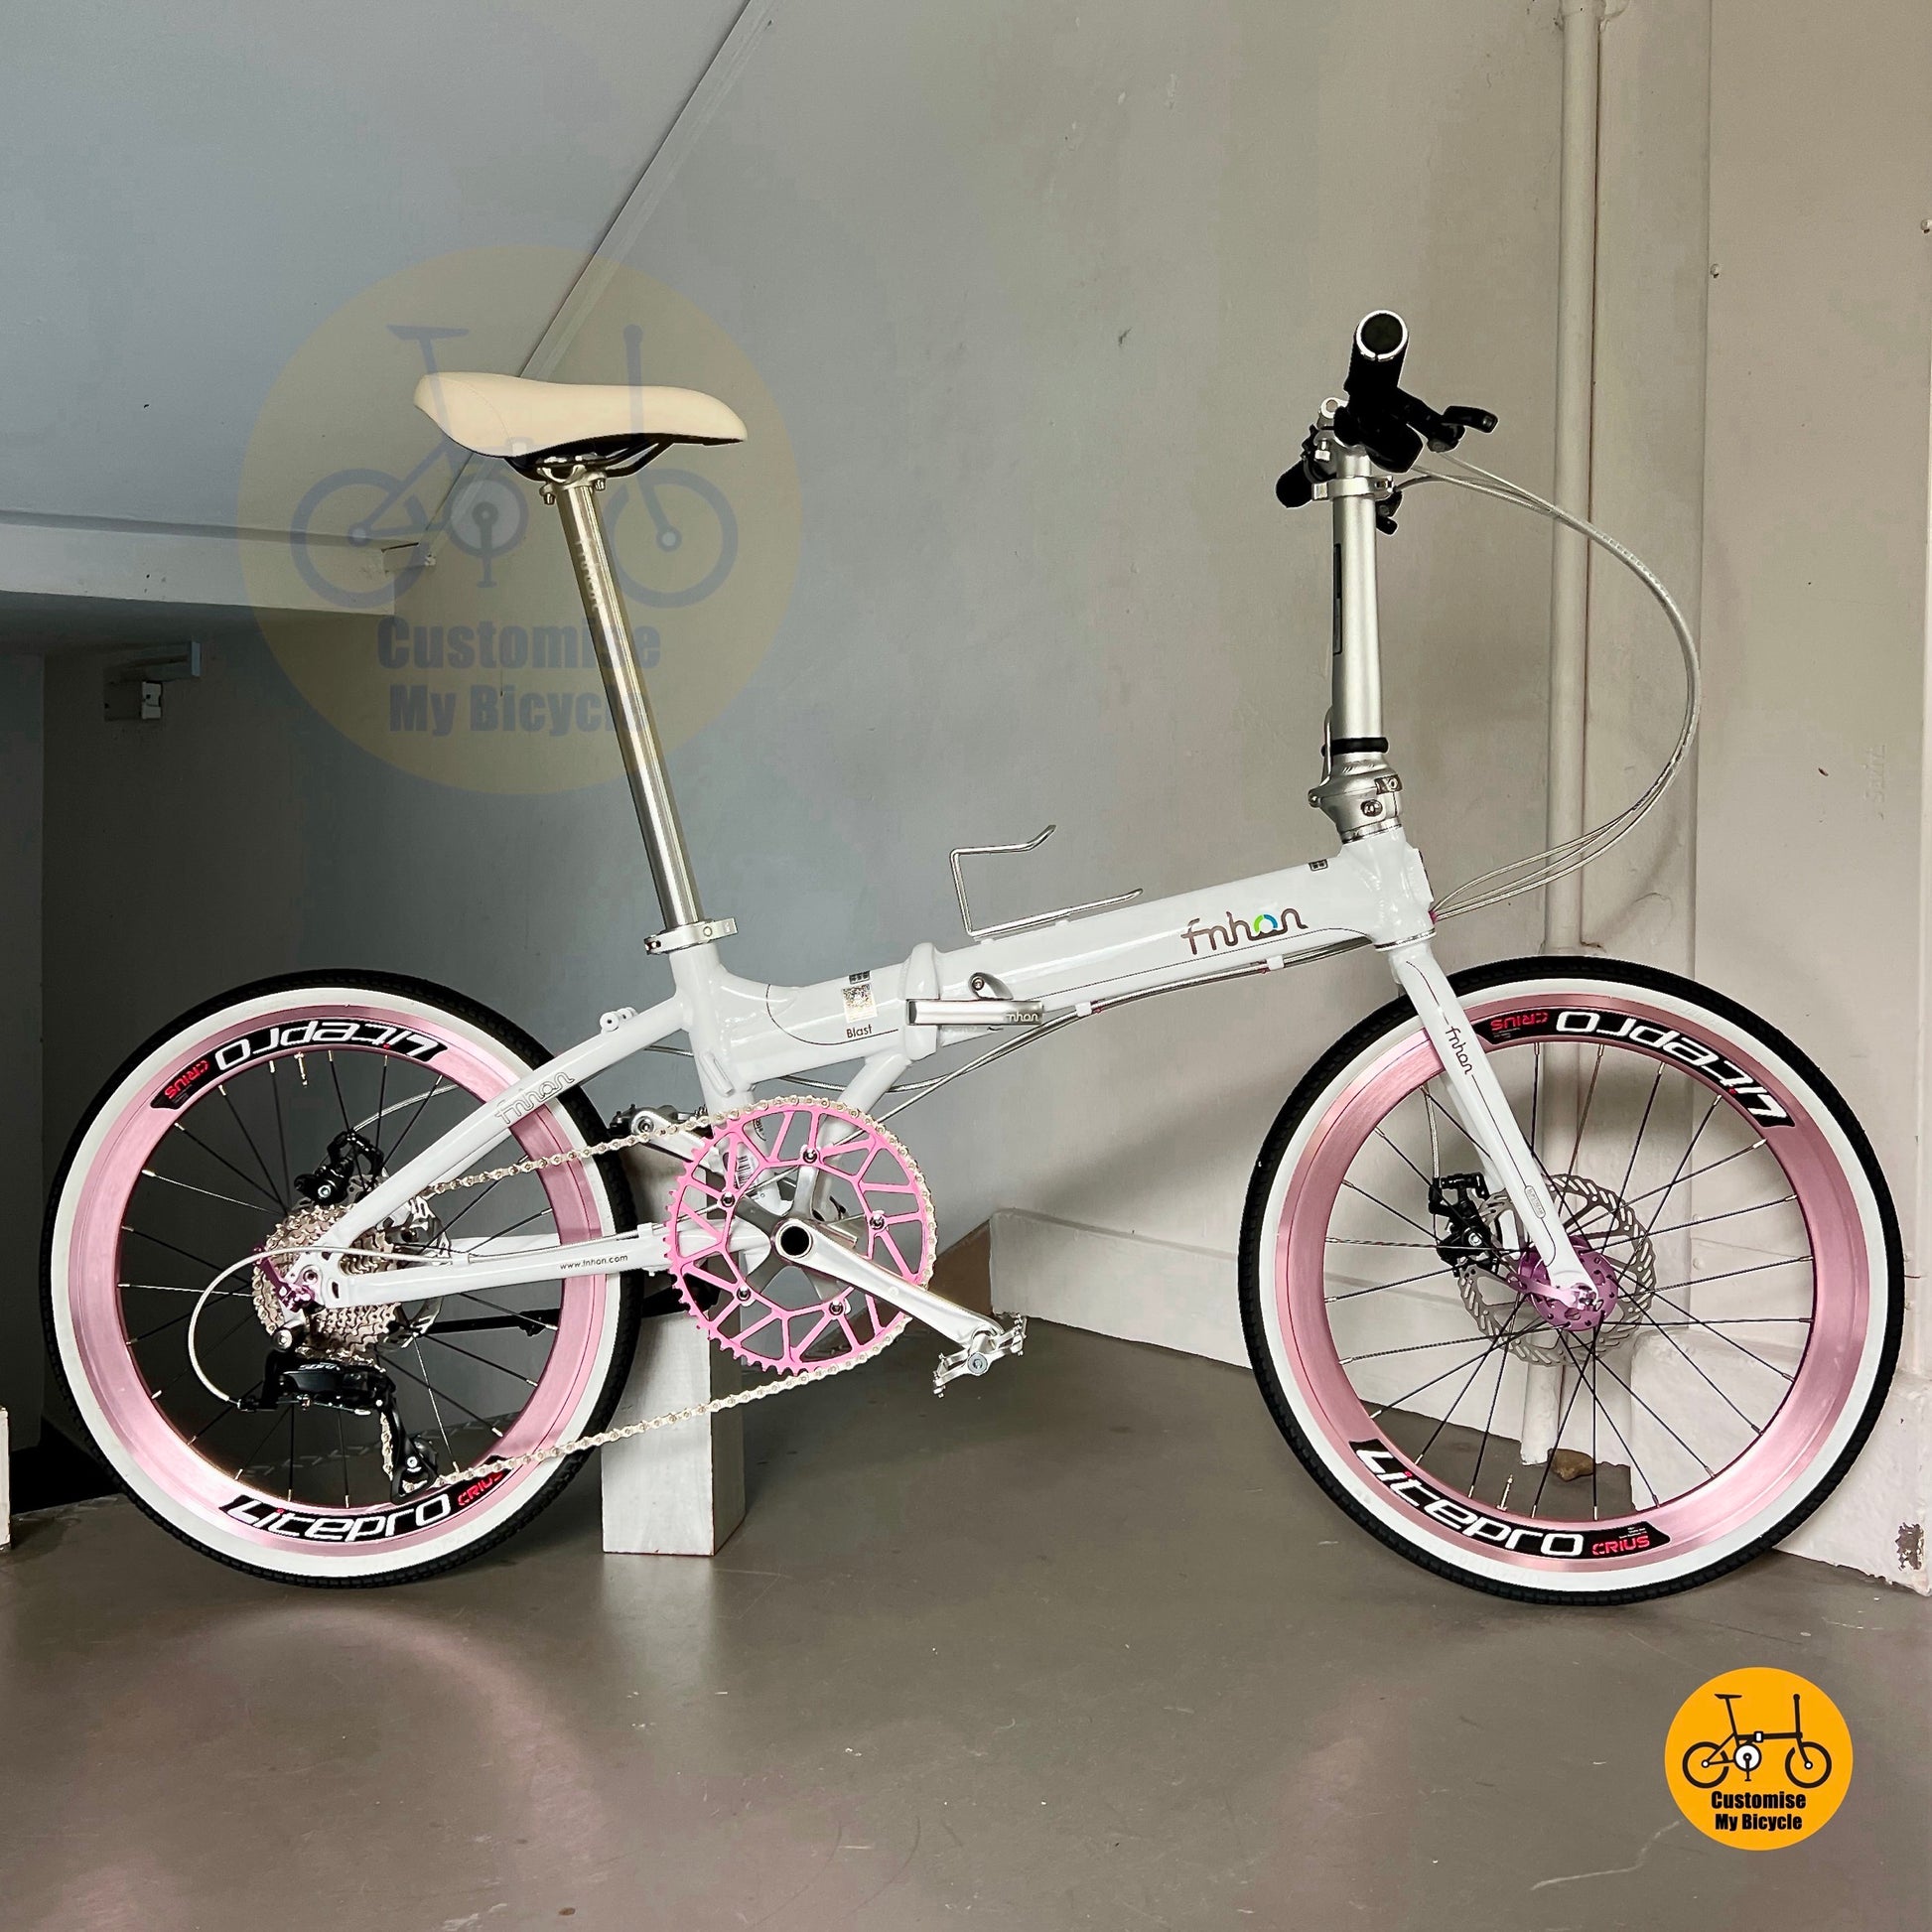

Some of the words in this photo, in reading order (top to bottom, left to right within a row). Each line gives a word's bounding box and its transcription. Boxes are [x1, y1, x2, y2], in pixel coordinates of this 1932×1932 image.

[1179, 907, 1310, 955] fnhon
[846, 1024, 873, 1038] Blast
[1490, 1012, 1549, 1032] CRIUS
[1445, 1026, 1472, 1075] fnhon
[164, 1059, 208, 1099] CRIUS
[1591, 1535, 1650, 1556] CRIUS
